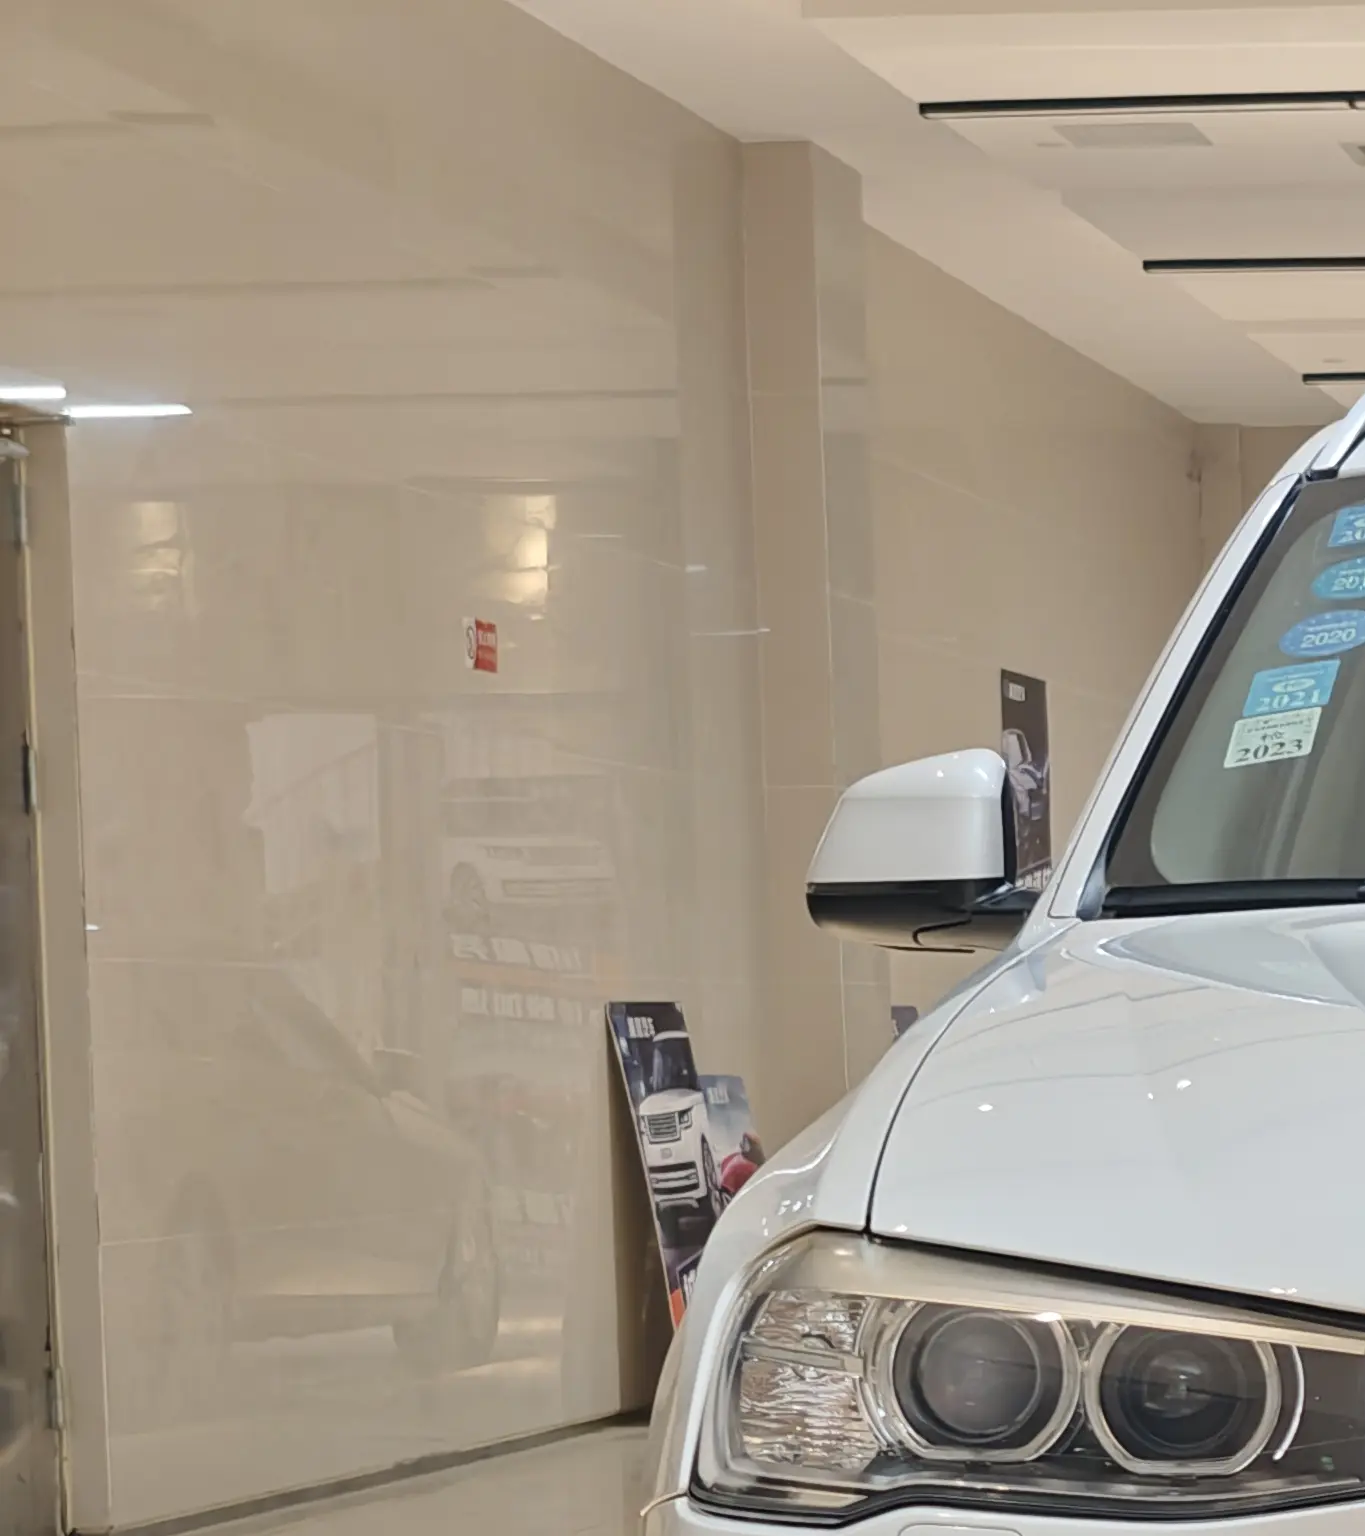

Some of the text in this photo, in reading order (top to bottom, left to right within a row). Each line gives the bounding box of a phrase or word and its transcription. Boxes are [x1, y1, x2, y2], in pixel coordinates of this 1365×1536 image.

[1300, 627, 1357, 649] 2020
[1255, 688, 1322, 712] 2021
[1235, 738, 1304, 763] 2023
